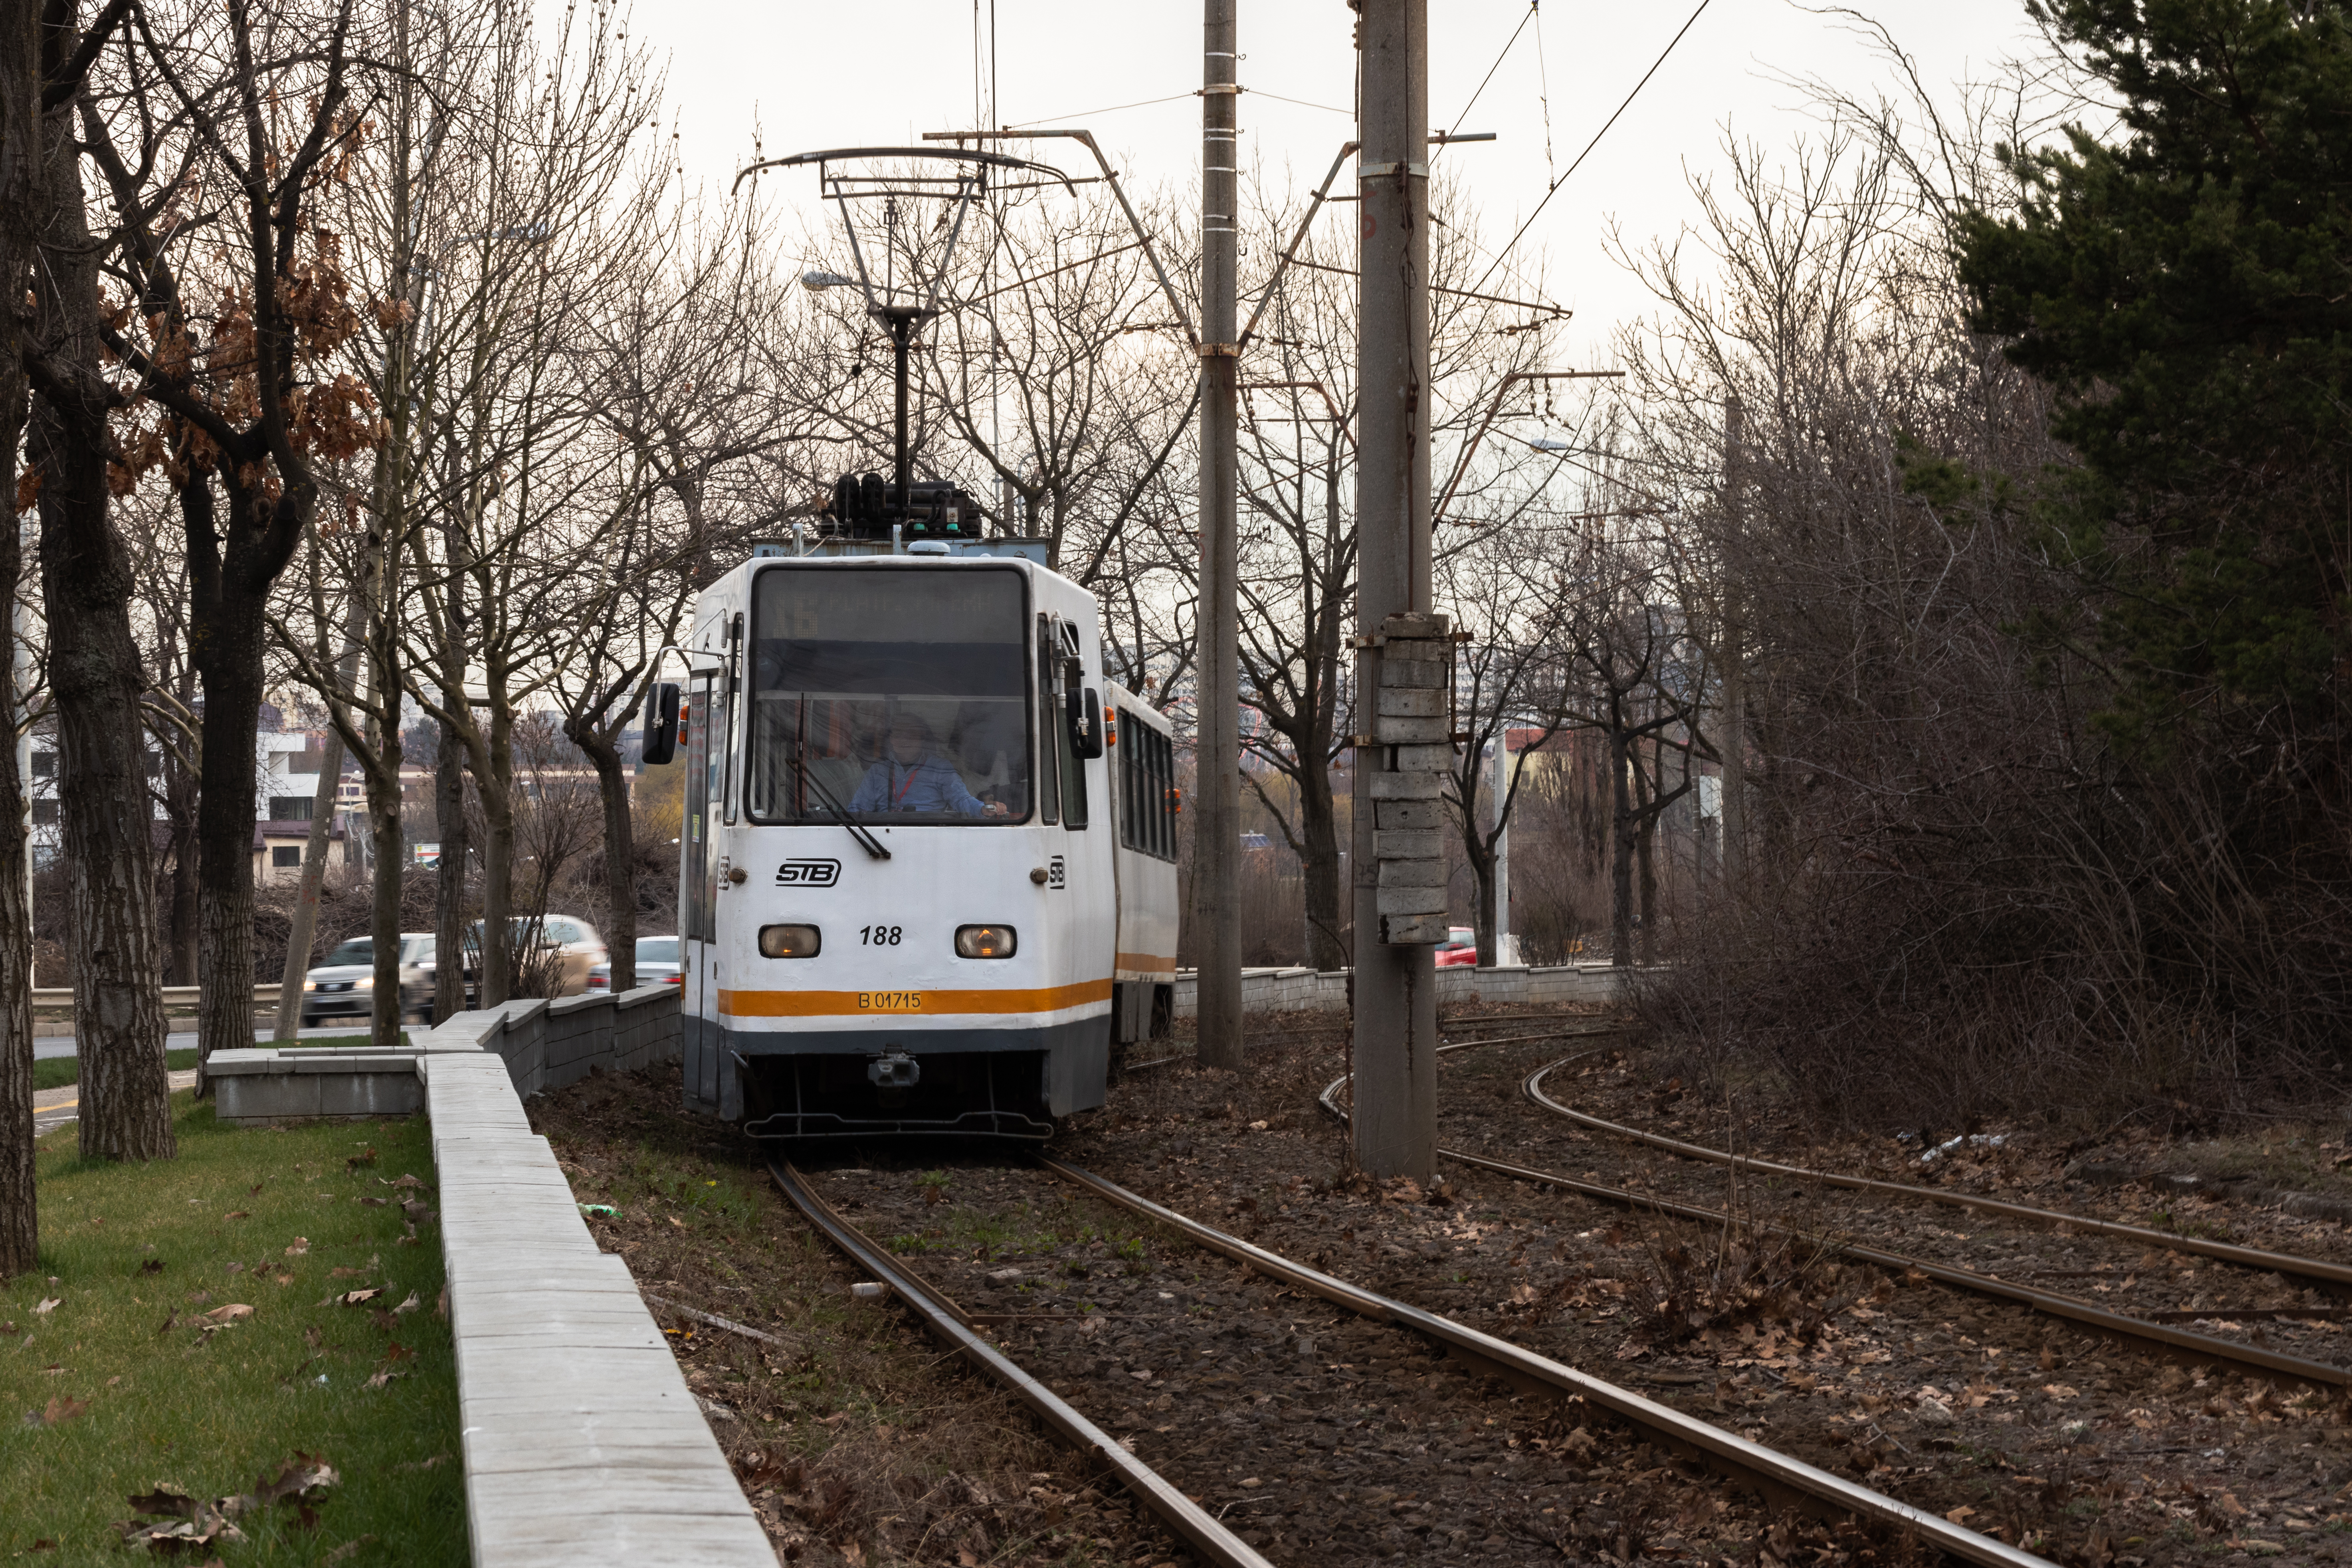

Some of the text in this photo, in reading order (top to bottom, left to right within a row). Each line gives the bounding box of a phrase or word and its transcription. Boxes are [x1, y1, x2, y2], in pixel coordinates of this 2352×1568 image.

[772, 591, 819, 638] 16
[776, 863, 835, 881] STB
[1049, 862, 1063, 883] STB
[860, 925, 902, 946] 188
[859, 993, 921, 1008] B 01715
